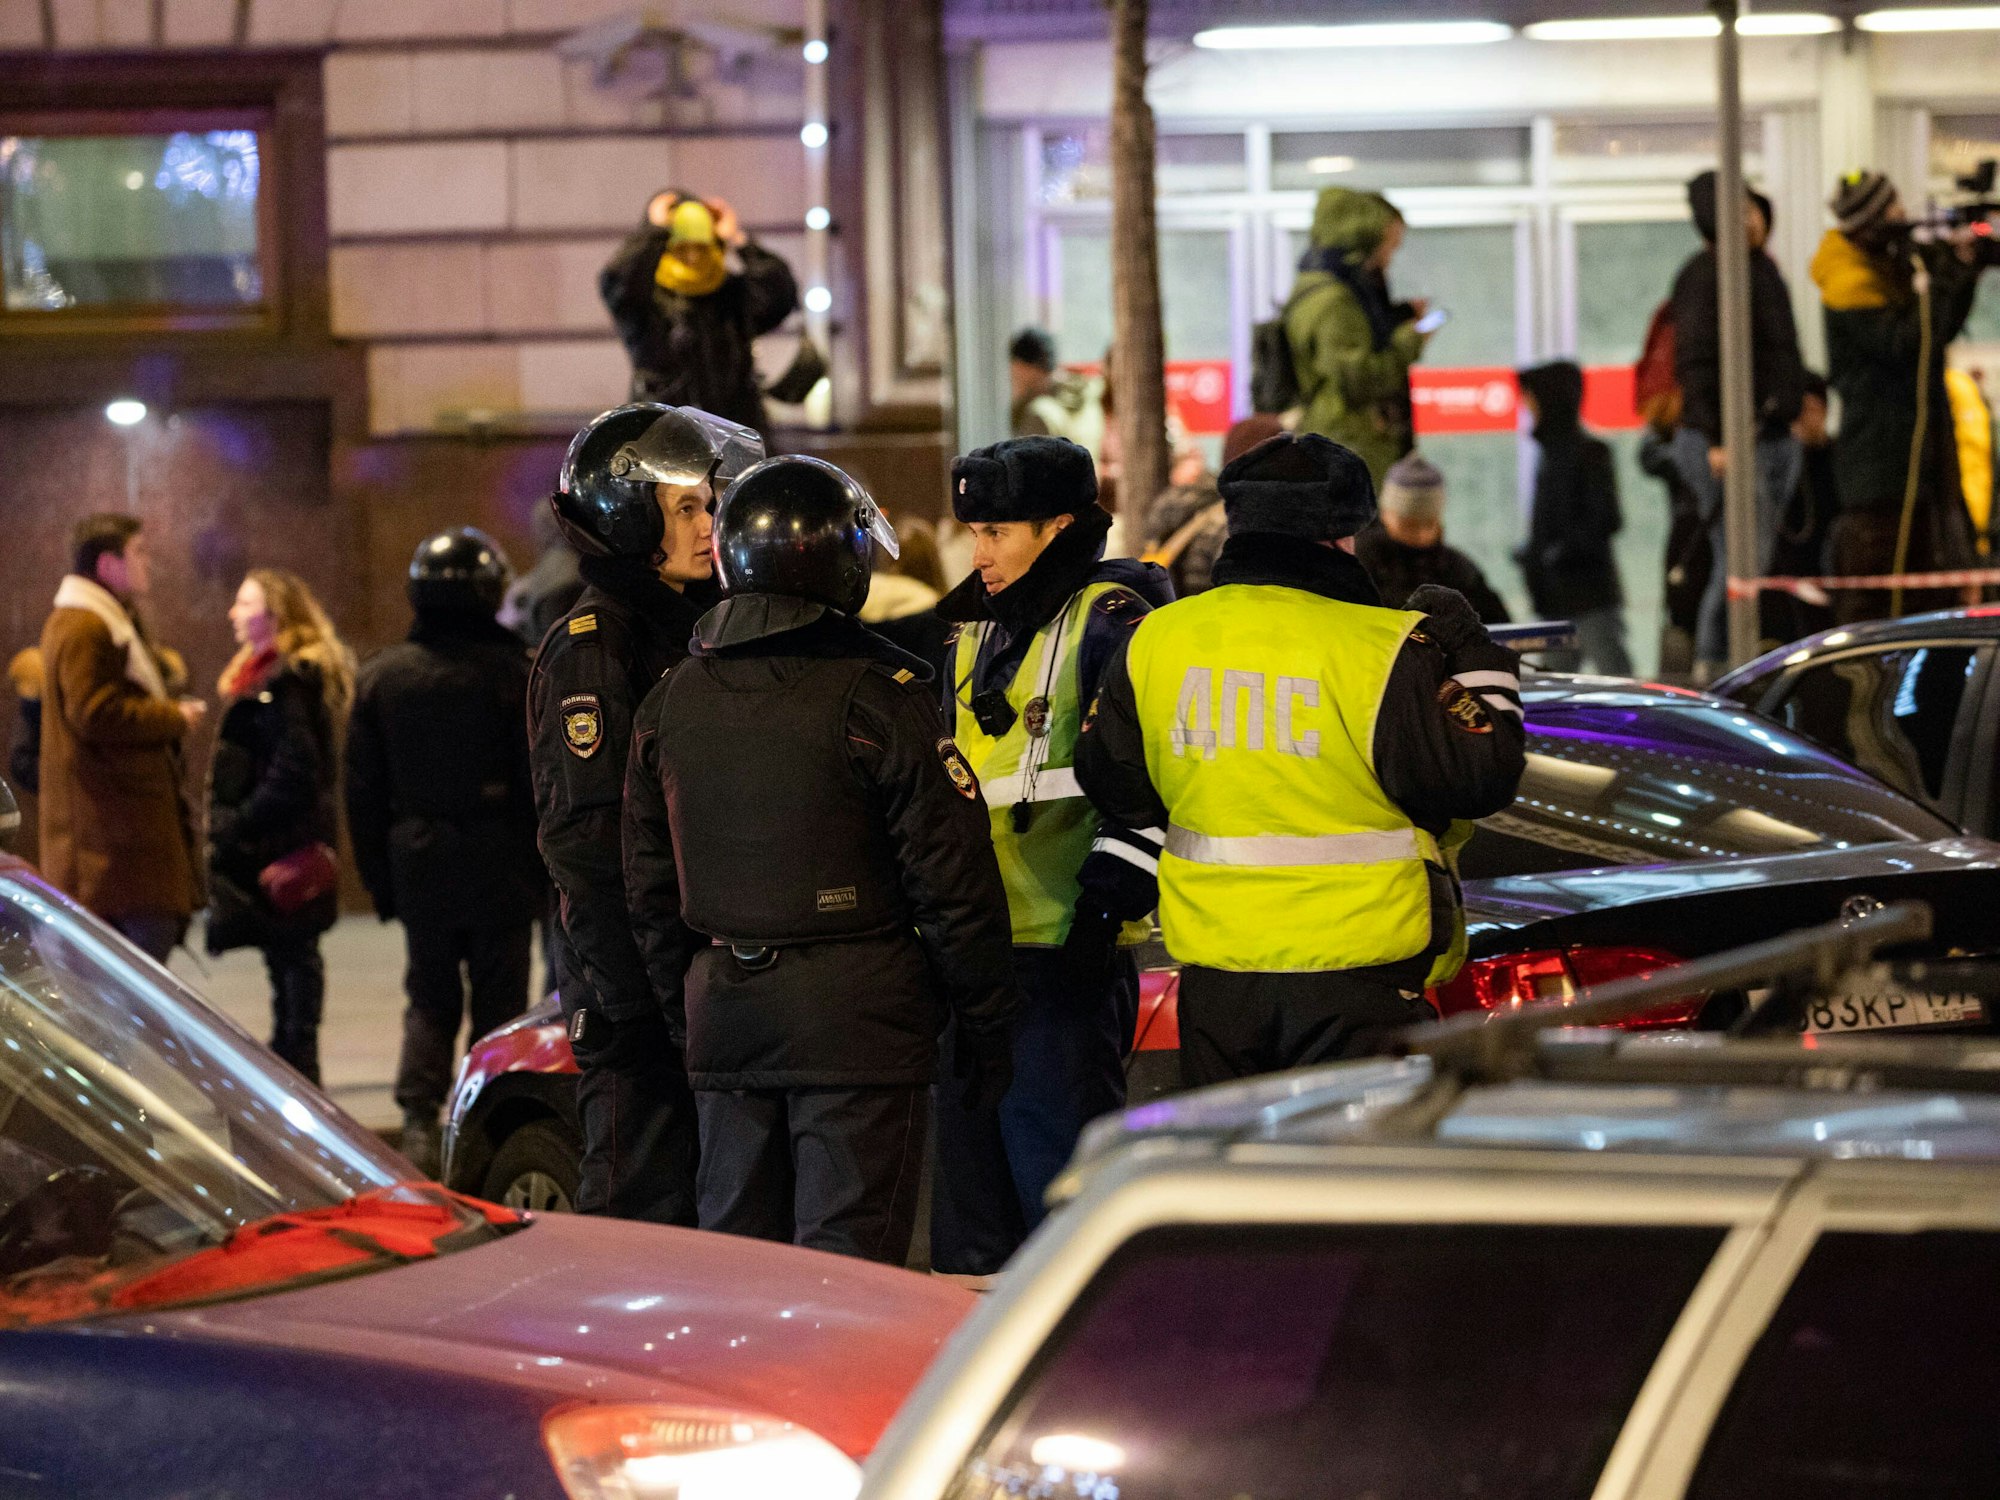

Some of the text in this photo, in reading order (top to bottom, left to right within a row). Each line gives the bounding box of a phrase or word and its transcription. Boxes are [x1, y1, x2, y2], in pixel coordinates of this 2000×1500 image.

[562, 695, 596, 706] ПОЛИЦИЯ
[1168, 666, 1321, 761] ДПС
[1933, 1008, 1961, 1019] RUS
